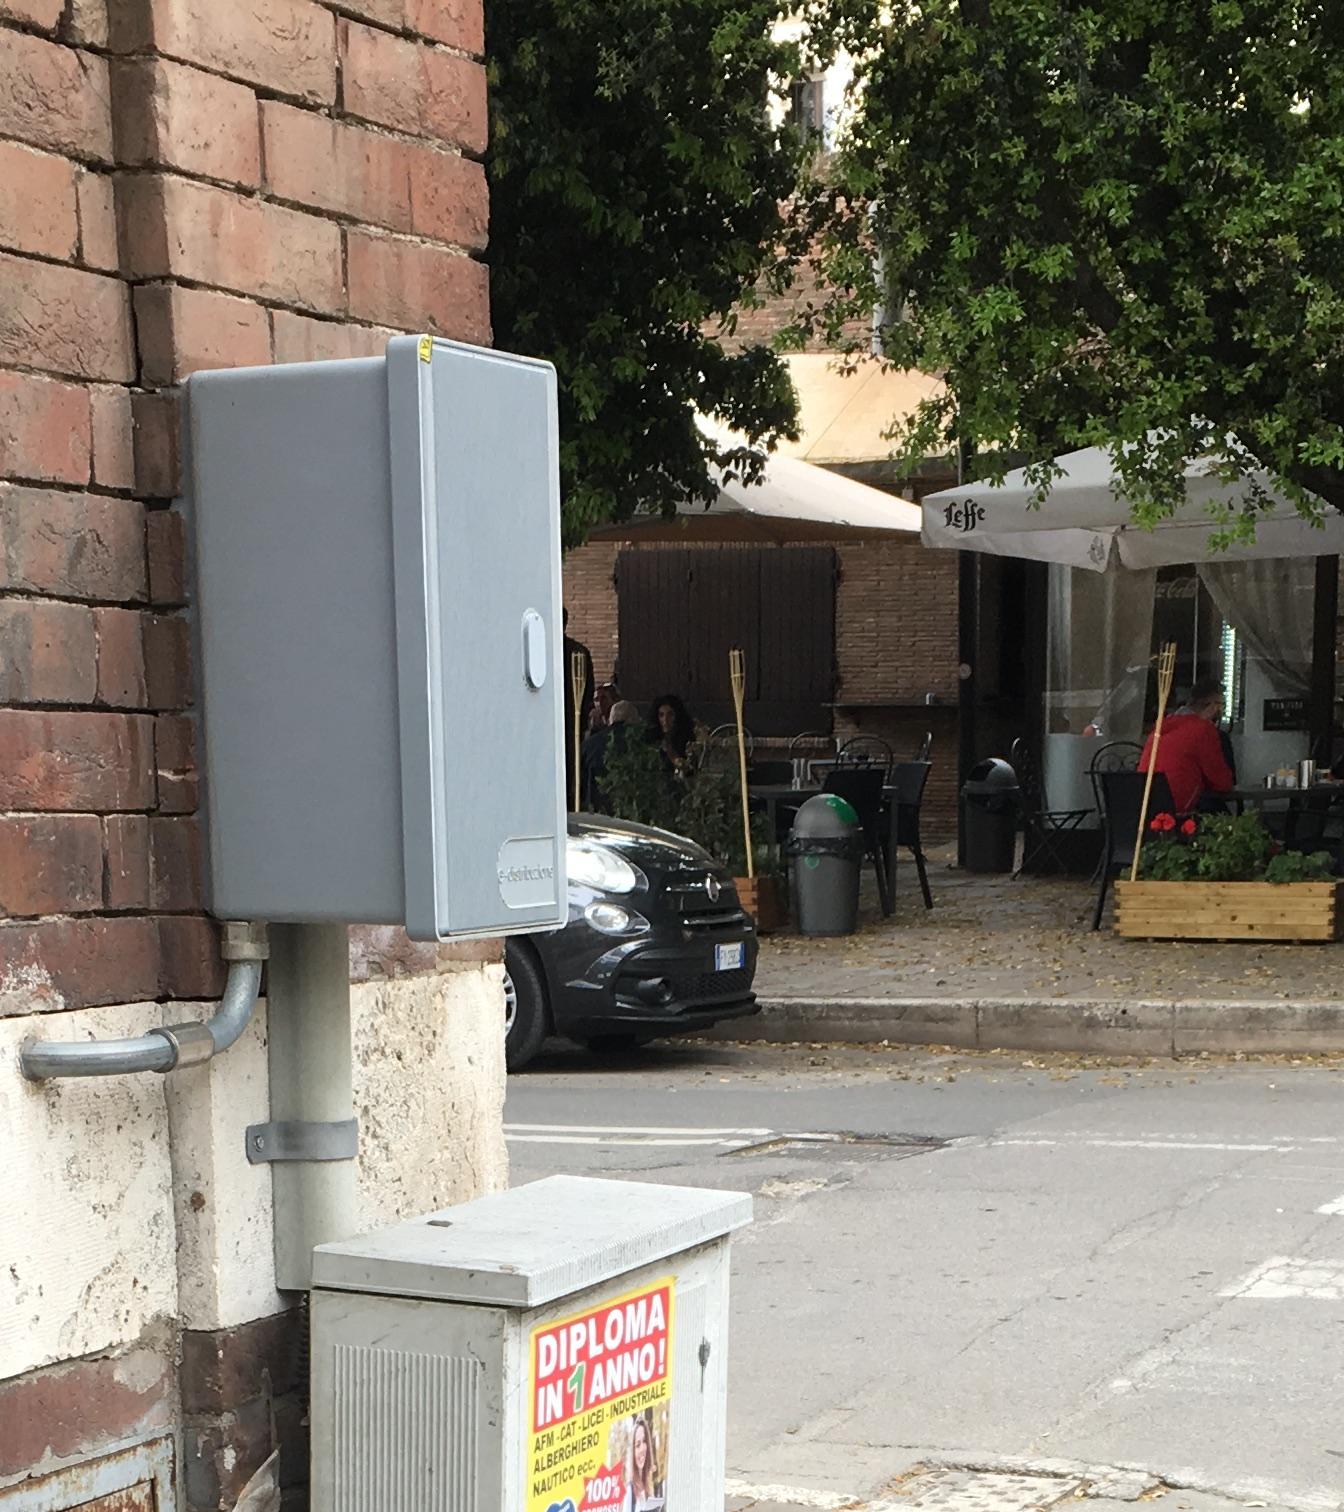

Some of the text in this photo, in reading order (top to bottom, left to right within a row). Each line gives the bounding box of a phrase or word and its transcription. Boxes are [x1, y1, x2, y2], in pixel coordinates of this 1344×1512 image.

[944, 499, 985, 532] Leffe
[538, 1293, 666, 1379] DIPLOMA
[537, 1338, 666, 1427] IN 1 ANNO!
[534, 1431, 554, 1453] AFM
[534, 1431, 599, 1475] ALBERGHIERO
[533, 1459, 596, 1498] NAUTICO ecc.
[586, 1476, 621, 1503] 100%
